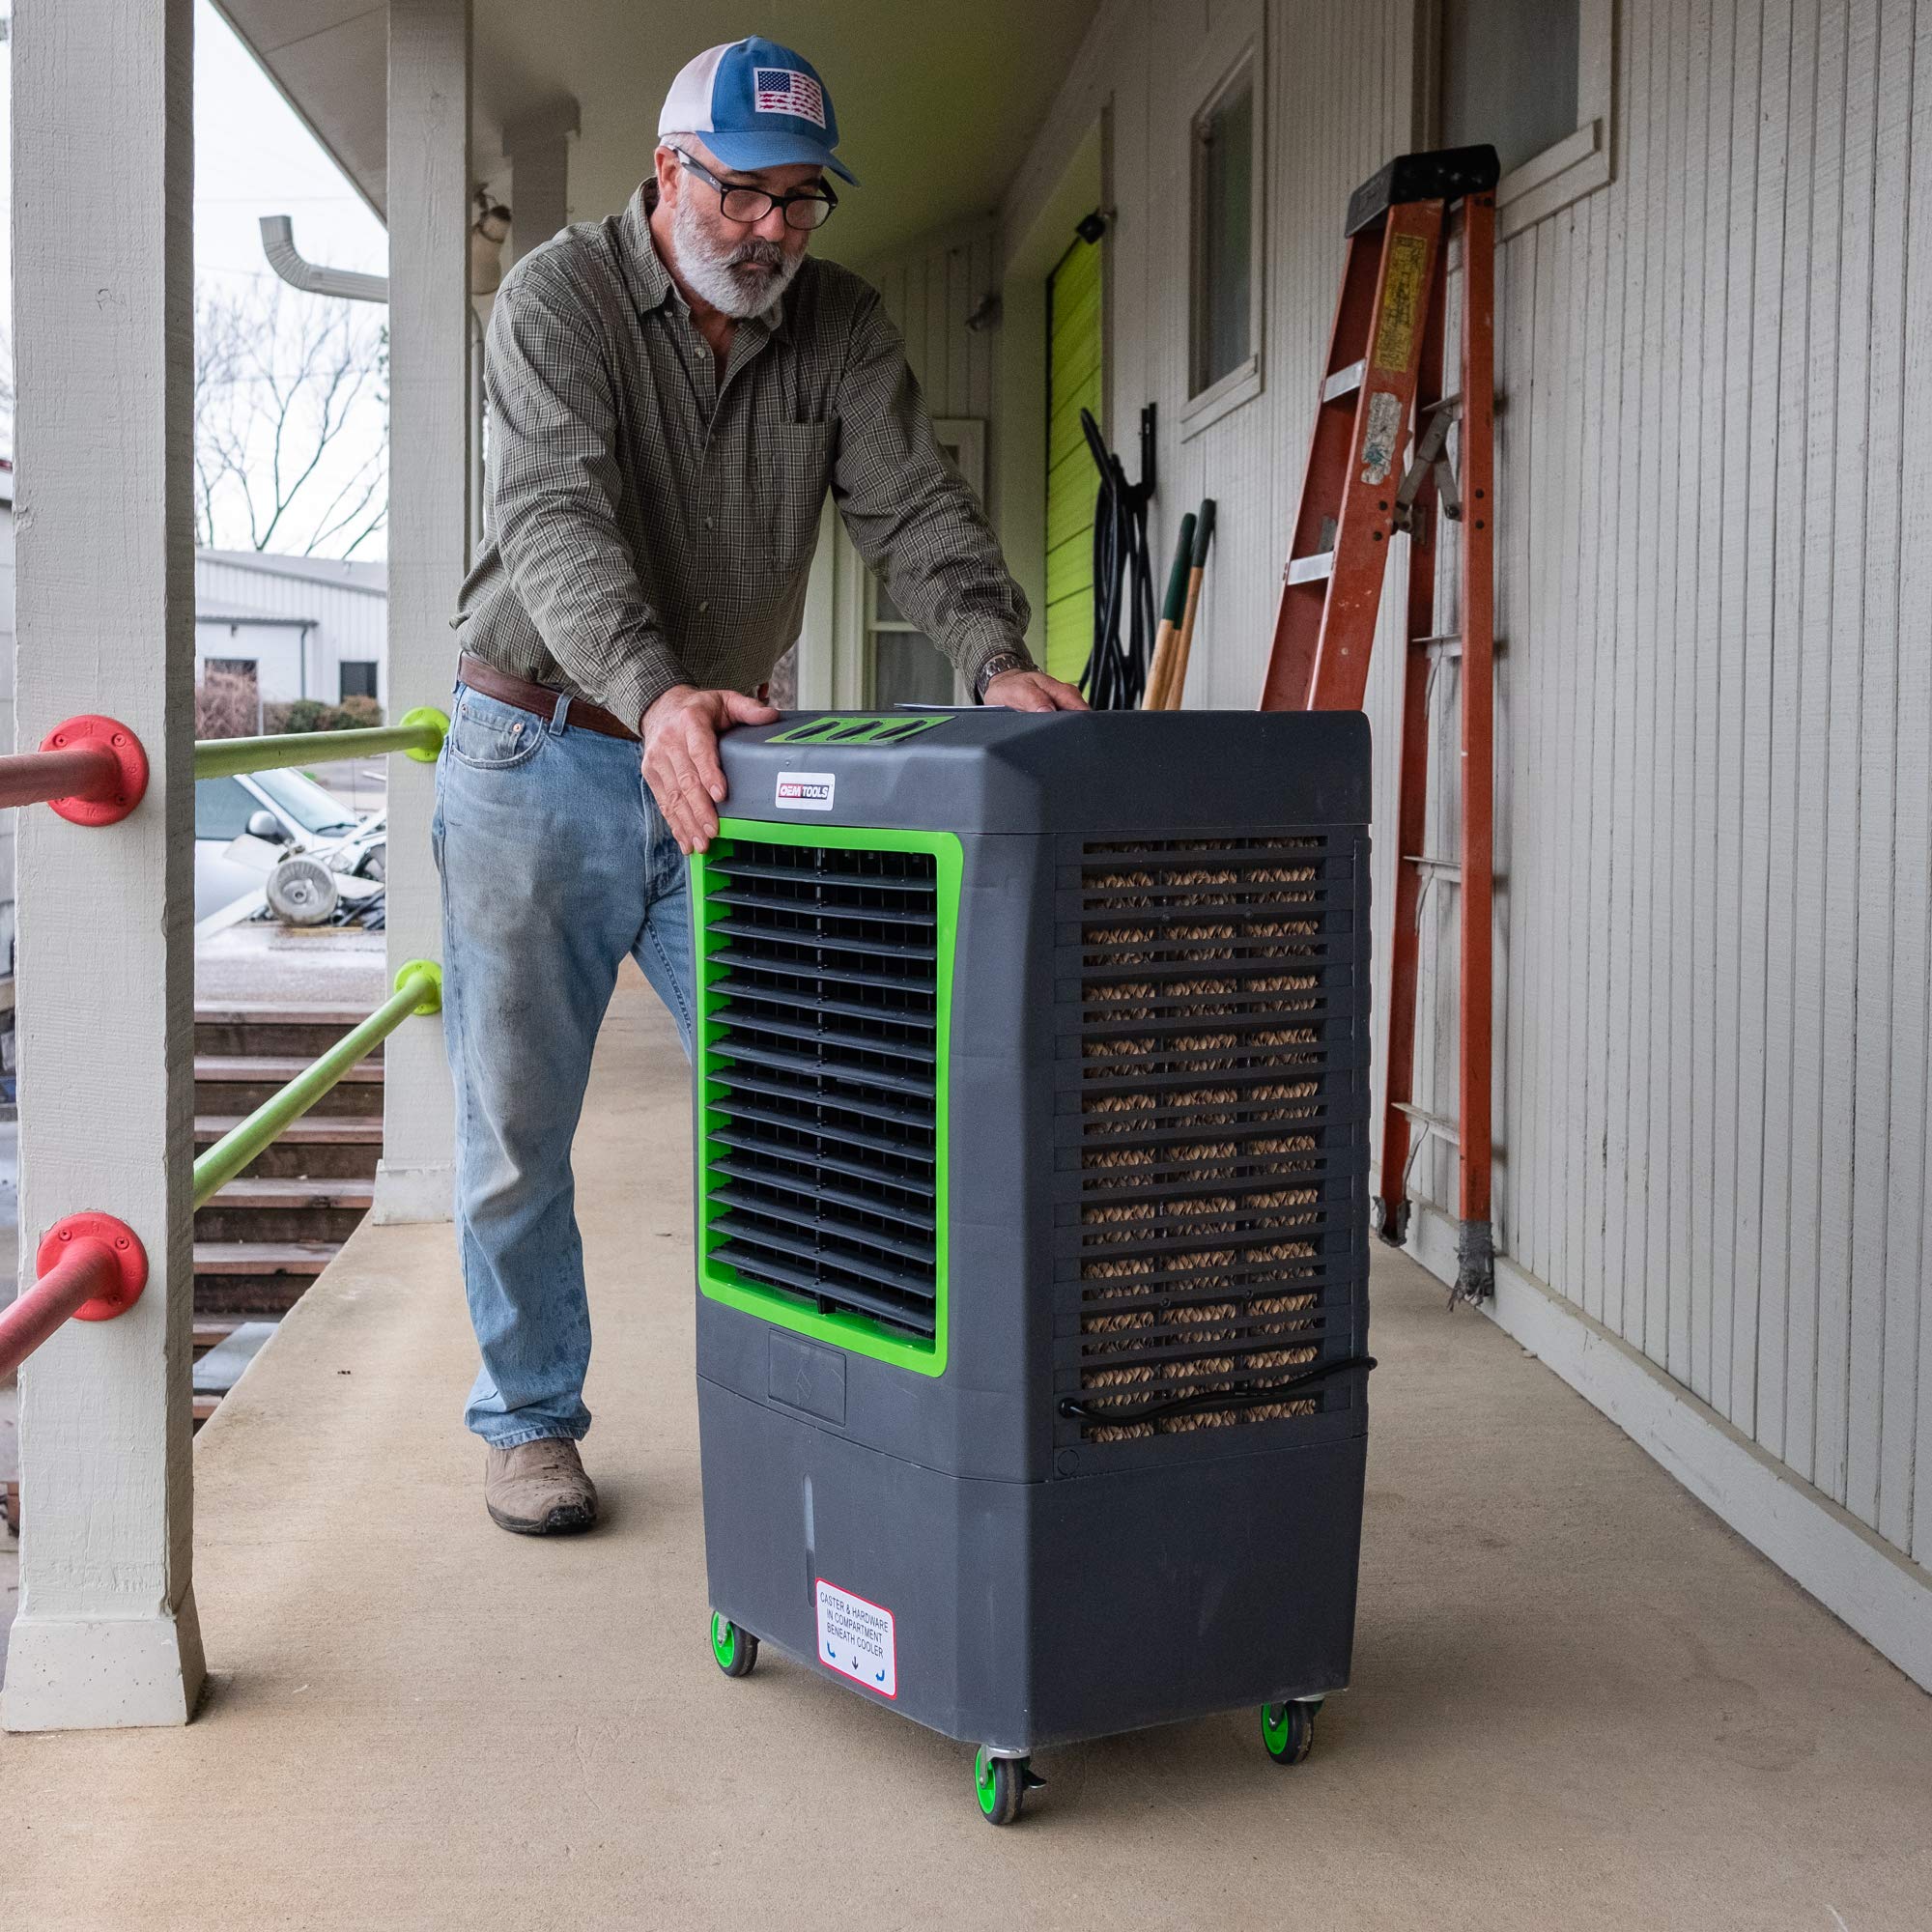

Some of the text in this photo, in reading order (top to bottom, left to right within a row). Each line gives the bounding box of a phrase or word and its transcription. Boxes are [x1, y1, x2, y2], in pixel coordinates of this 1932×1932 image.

[819, 1591, 845, 1612] CASTER
[852, 1606, 889, 1633] HARDWARE
[826, 1607, 883, 1643] IN COMPARTMENT
[826, 1622, 884, 1659] BENEATH COOLER
